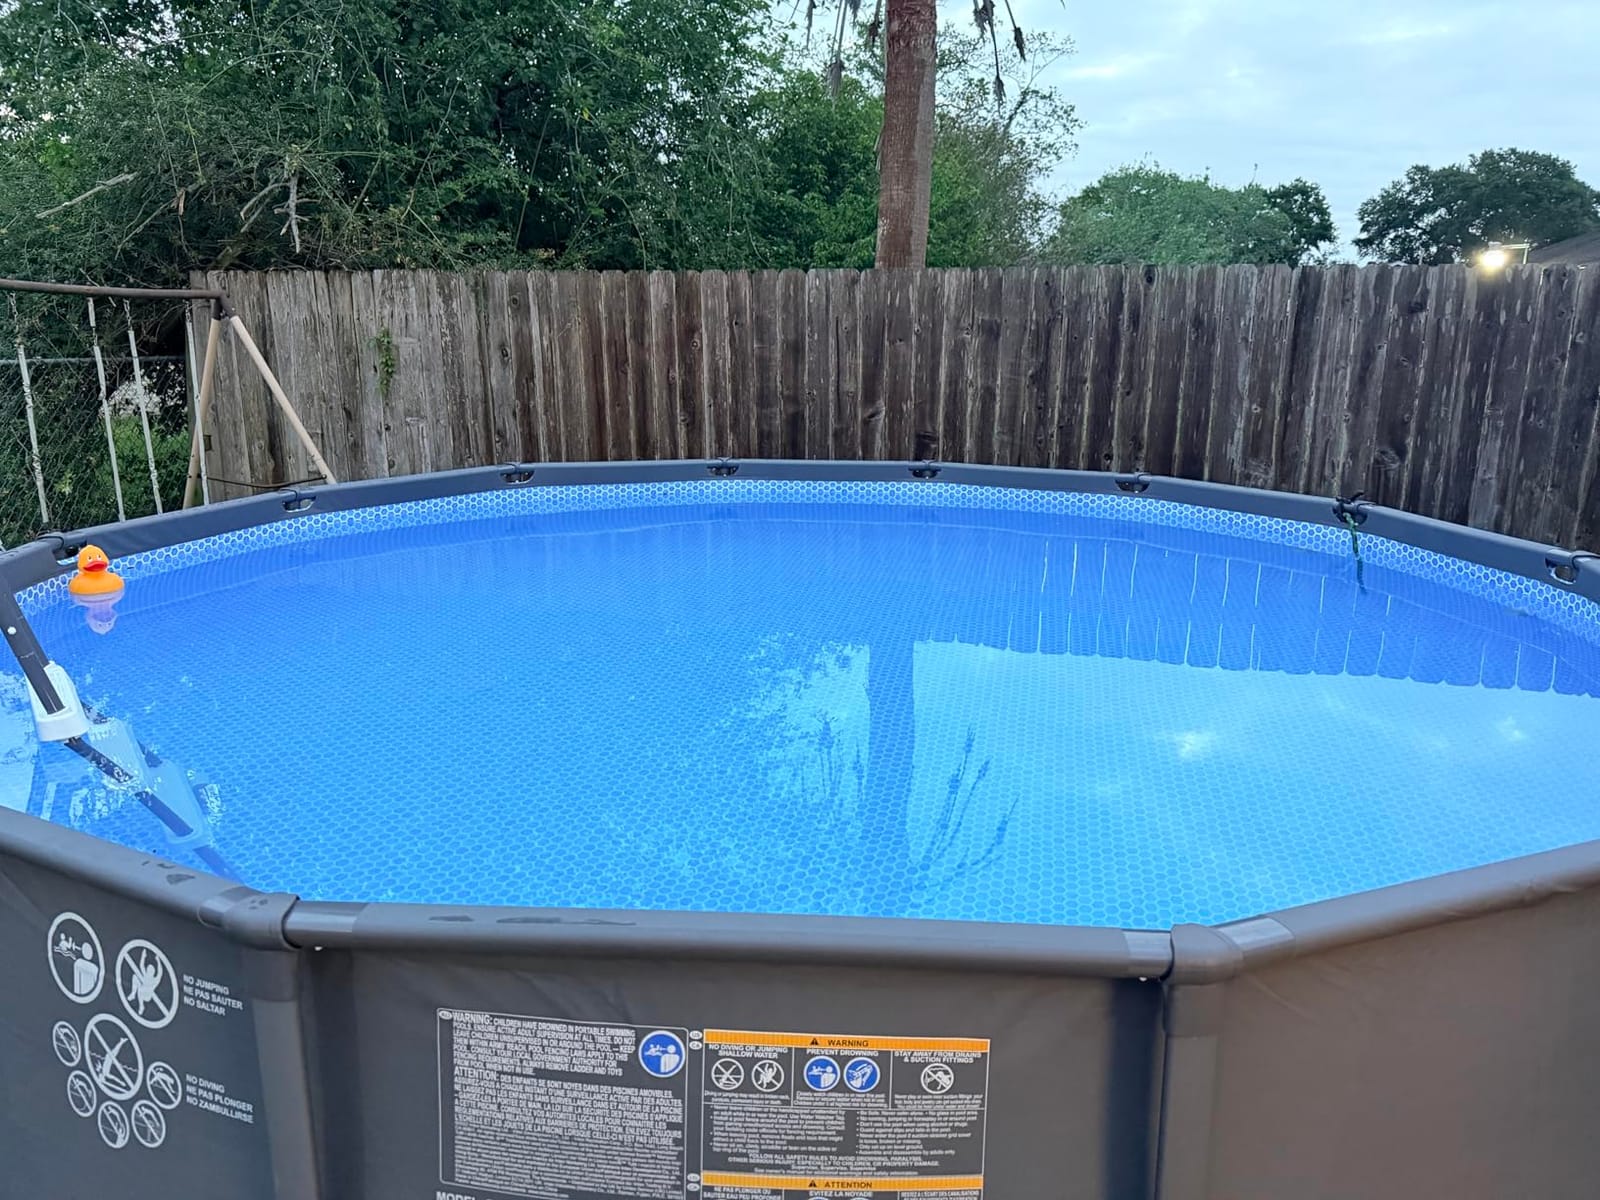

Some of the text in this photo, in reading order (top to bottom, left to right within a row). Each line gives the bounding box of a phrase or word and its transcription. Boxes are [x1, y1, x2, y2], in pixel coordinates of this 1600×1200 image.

[183, 974, 229, 995] NO JUMPING
[183, 985, 243, 1010] NE PAS SAUTER
[183, 995, 226, 1016] NO SALTAR
[453, 1012, 493, 1025] WARNING:
[828, 1039, 869, 1048] WARNING
[454, 1066, 499, 1080] ATTENTION:
[186, 1074, 225, 1093] NO DIVING
[186, 1085, 253, 1112] NE PAS PLONGER
[187, 1095, 254, 1123] NO ZAMBULLIRSE
[824, 1181, 873, 1189] ATTENTION
